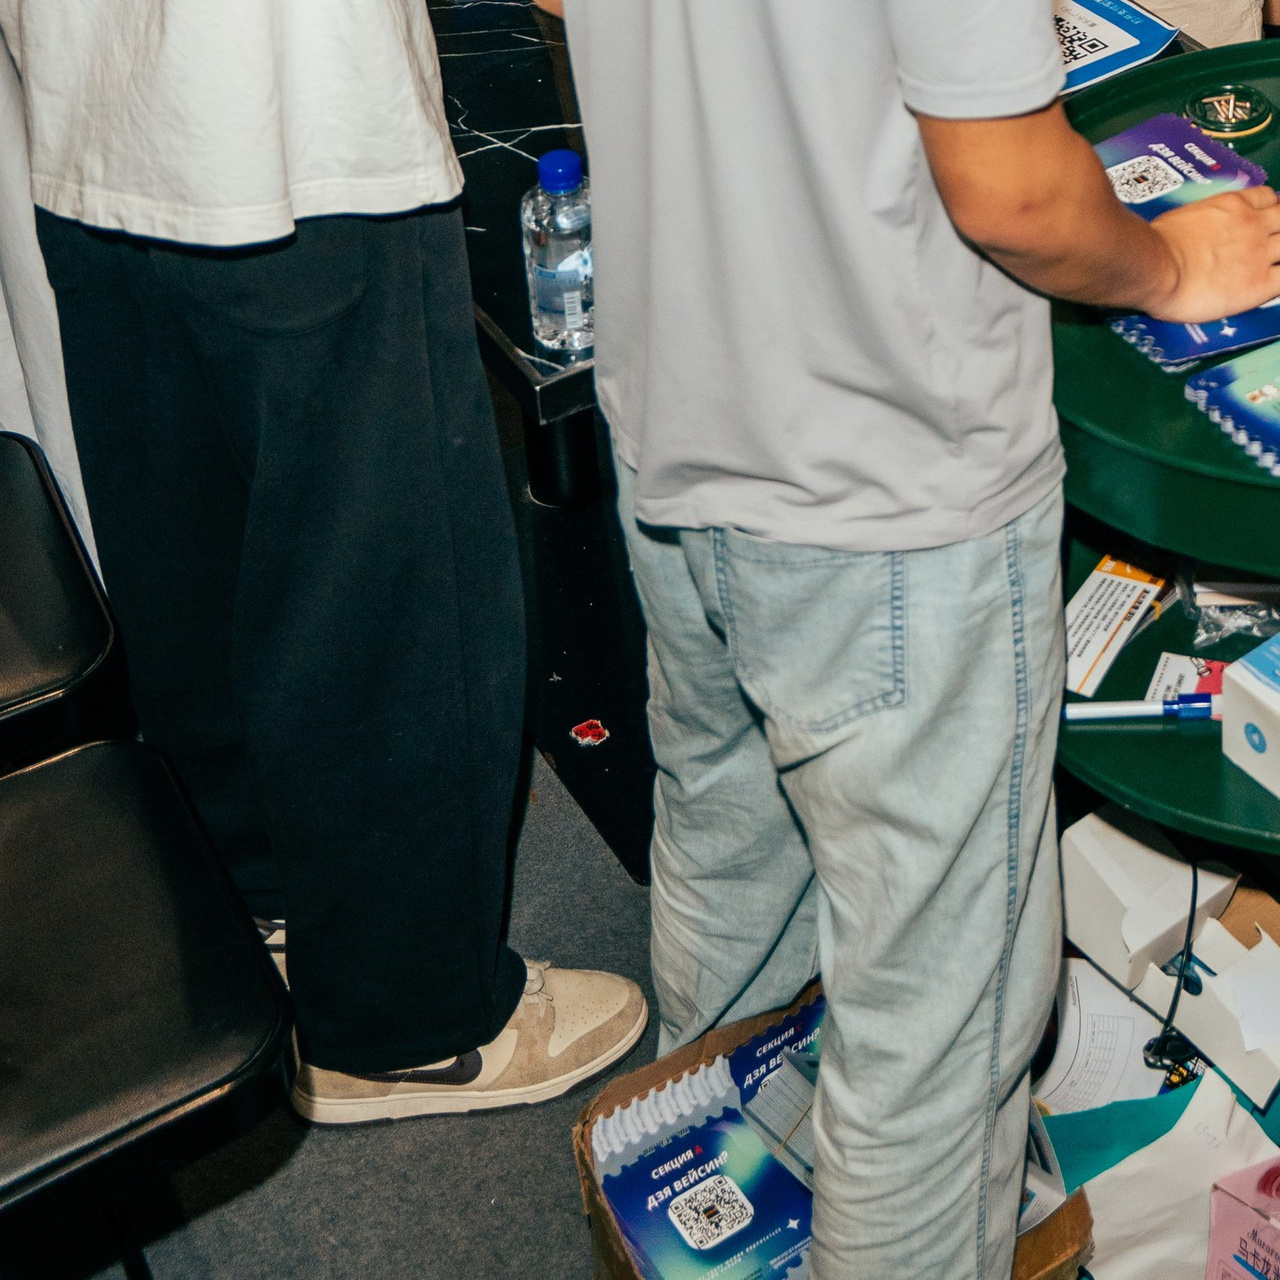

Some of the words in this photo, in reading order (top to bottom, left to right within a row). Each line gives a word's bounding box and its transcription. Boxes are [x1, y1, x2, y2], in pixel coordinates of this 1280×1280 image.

[744, 1063, 767, 1089] ДЗЯ
[769, 1027, 821, 1070] ВЕСИН?
[756, 1027, 795, 1058] СЕКЦИЯ
[647, 1186, 673, 1211] ДЗЯ
[674, 1151, 729, 1192] ВЕЙСИН?
[652, 1149, 694, 1180] СЕКЦИЯ
